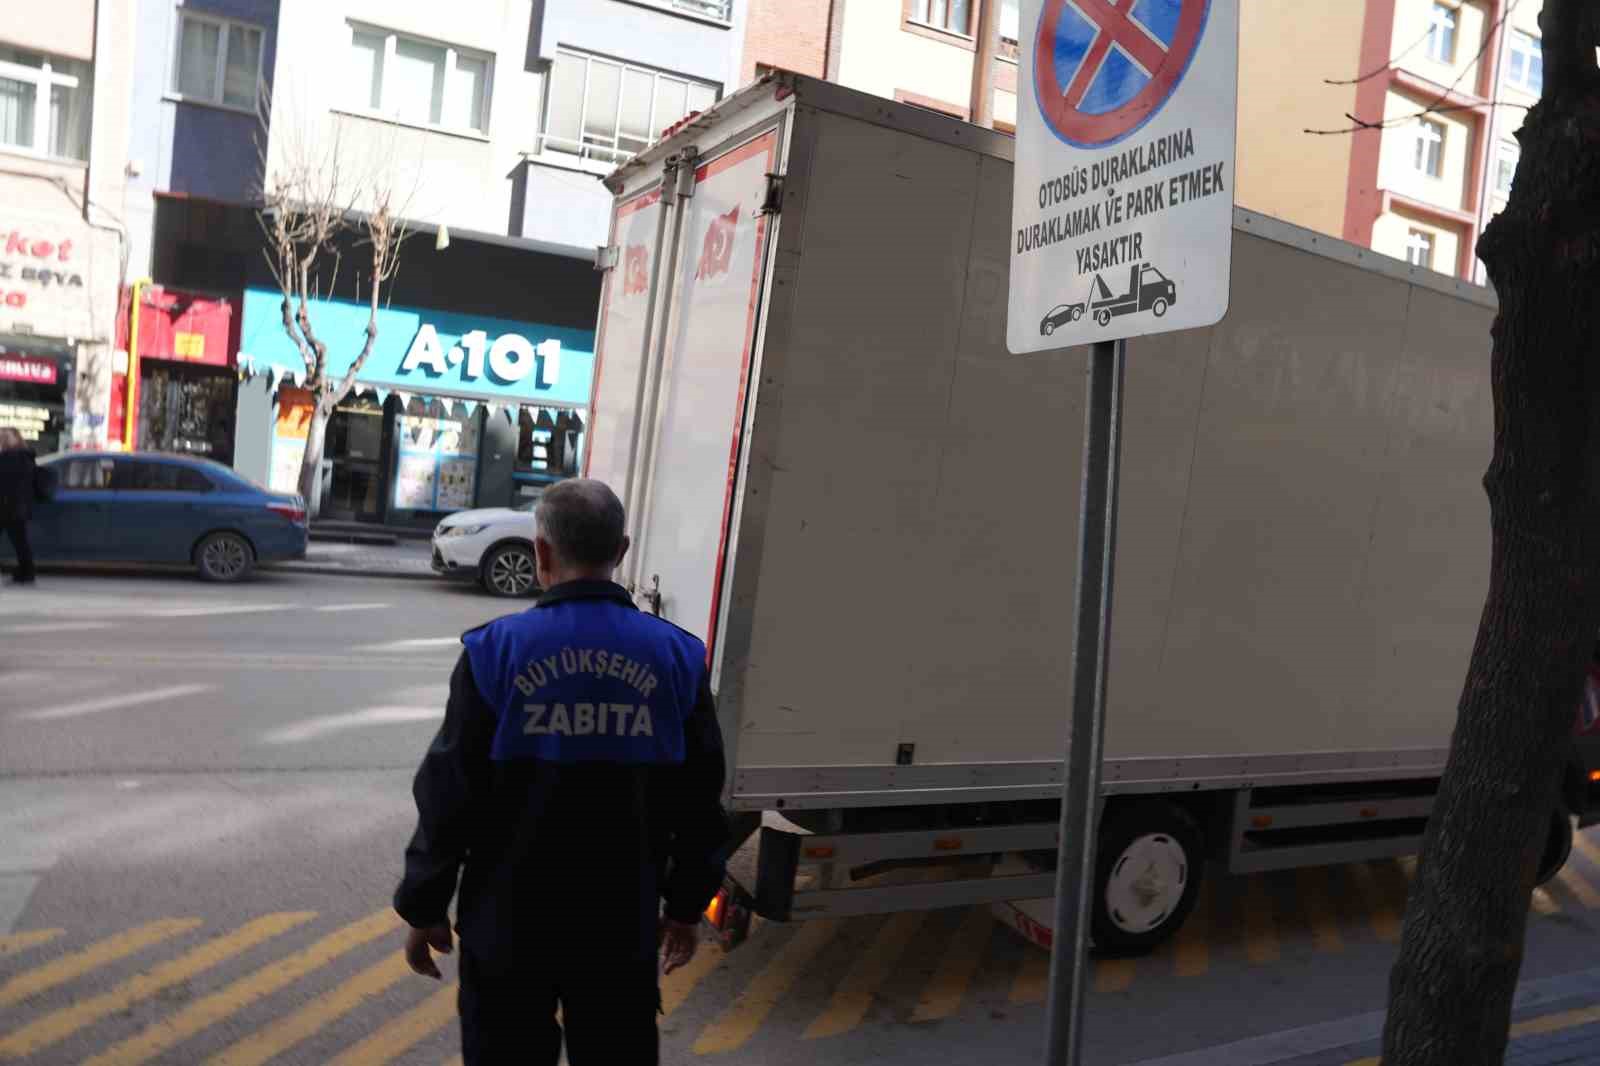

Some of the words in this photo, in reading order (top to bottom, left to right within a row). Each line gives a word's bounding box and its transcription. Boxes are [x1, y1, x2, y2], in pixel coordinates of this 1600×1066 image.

[1039, 165, 1087, 209] OTOBÜS
[1091, 127, 1195, 191] DURAKLARINA
[1017, 203, 1101, 254] DURAKLAMAK
[1105, 194, 1122, 227] VE
[1126, 181, 1165, 220] PARK
[1169, 161, 1225, 207] ETMEK
[0, 230, 72, 262] ket
[1076, 231, 1143, 275] YASAKTIR
[513, 647, 659, 698] BÜYÜKŞEHİR
[523, 702, 654, 737] ZABITA
